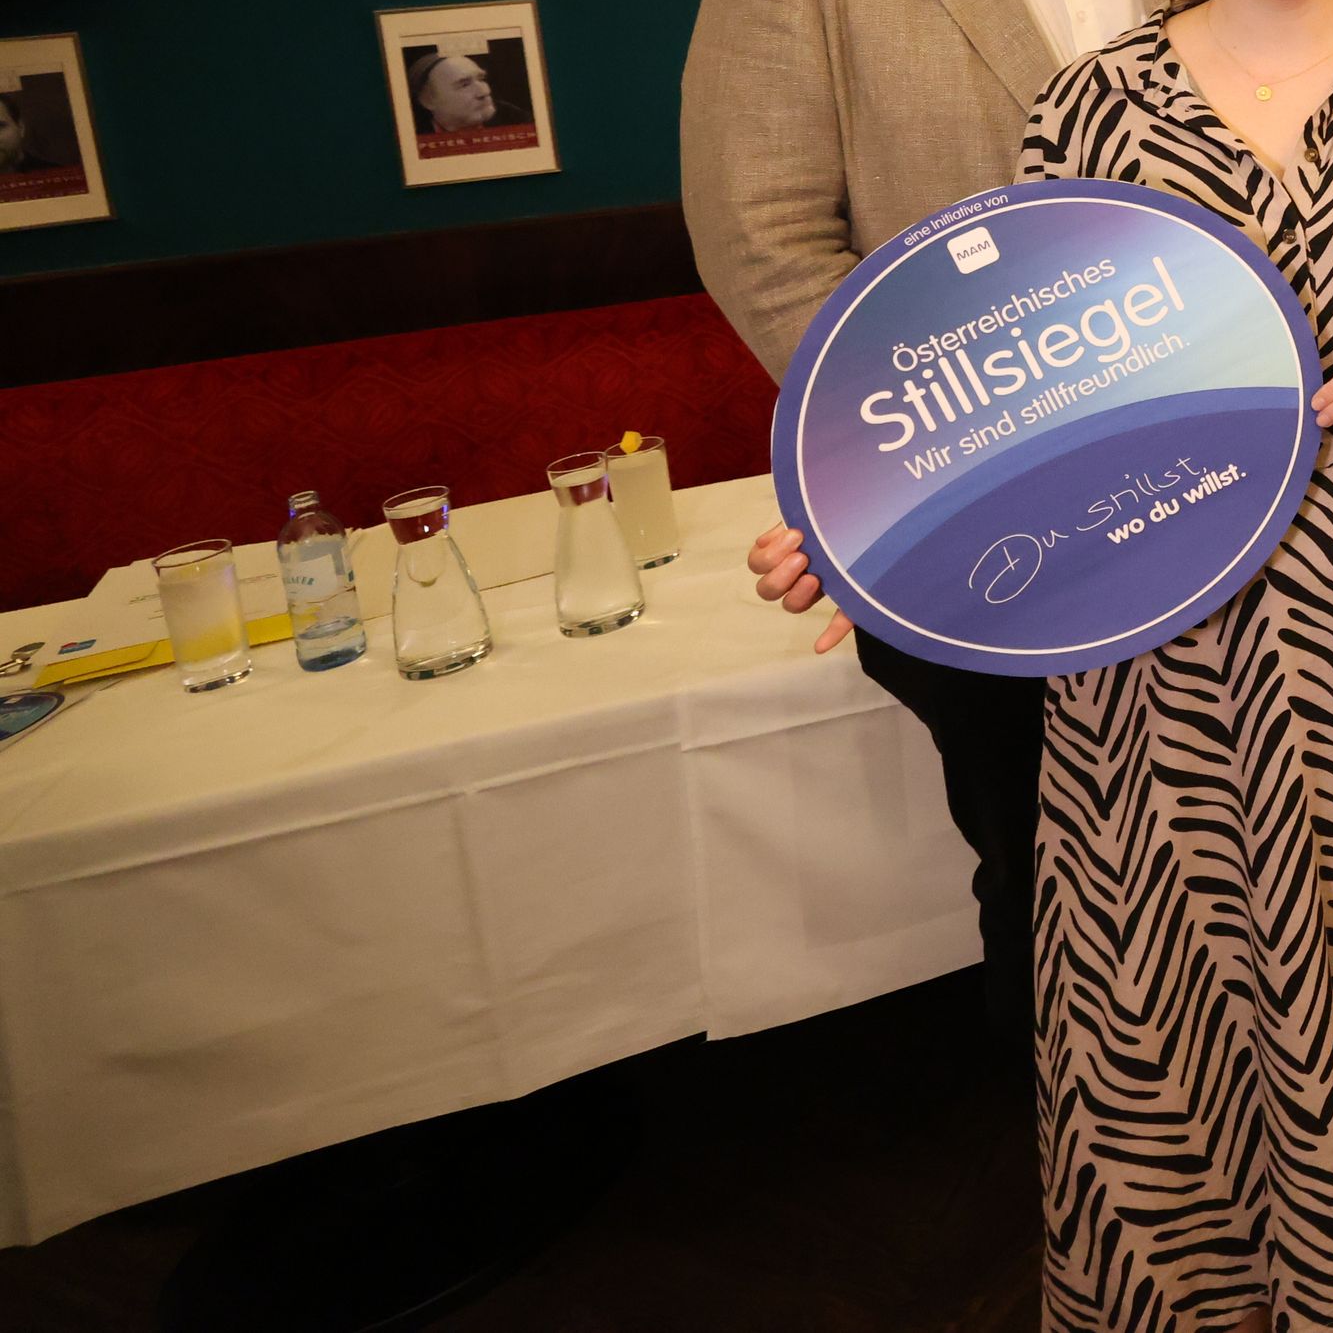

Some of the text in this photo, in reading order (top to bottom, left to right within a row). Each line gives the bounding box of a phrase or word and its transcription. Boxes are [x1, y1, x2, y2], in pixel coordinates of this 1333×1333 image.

[904, 193, 1010, 248] eine Initiative von
[956, 239, 992, 261] MAM
[859, 255, 1185, 453] Stillsiegel
[892, 257, 1117, 372] Österreichisches
[904, 331, 1191, 481] Wir sind stillfreundlich.
[1107, 463, 1248, 546] wo du willst.
[968, 526, 1069, 605] Du
